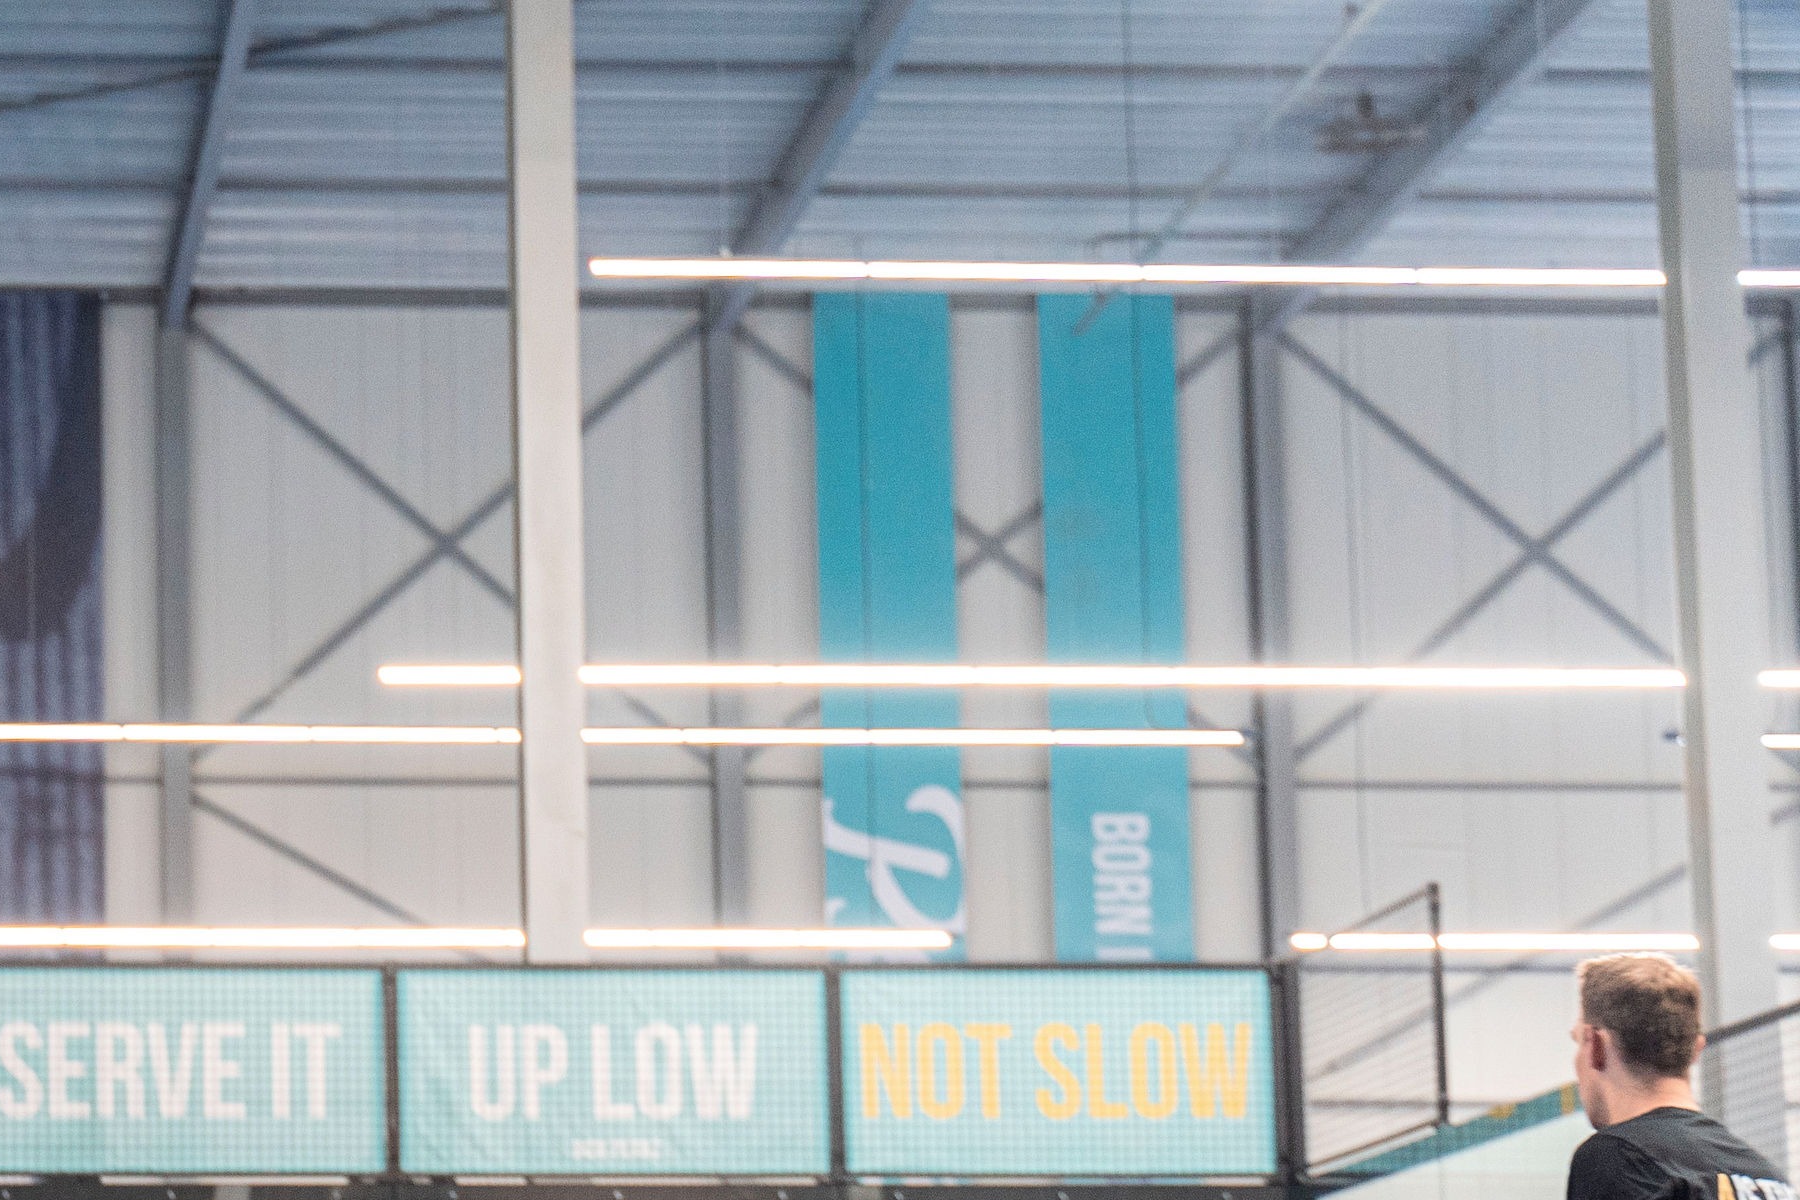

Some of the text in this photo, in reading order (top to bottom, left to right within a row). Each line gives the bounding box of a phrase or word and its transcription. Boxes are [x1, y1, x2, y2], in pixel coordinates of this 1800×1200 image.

[1090, 811, 1153, 936] BORN
[270, 1022, 344, 1120] IT
[467, 1022, 759, 1121] UP LOW
[859, 1022, 1252, 1120] NOT SLOW
